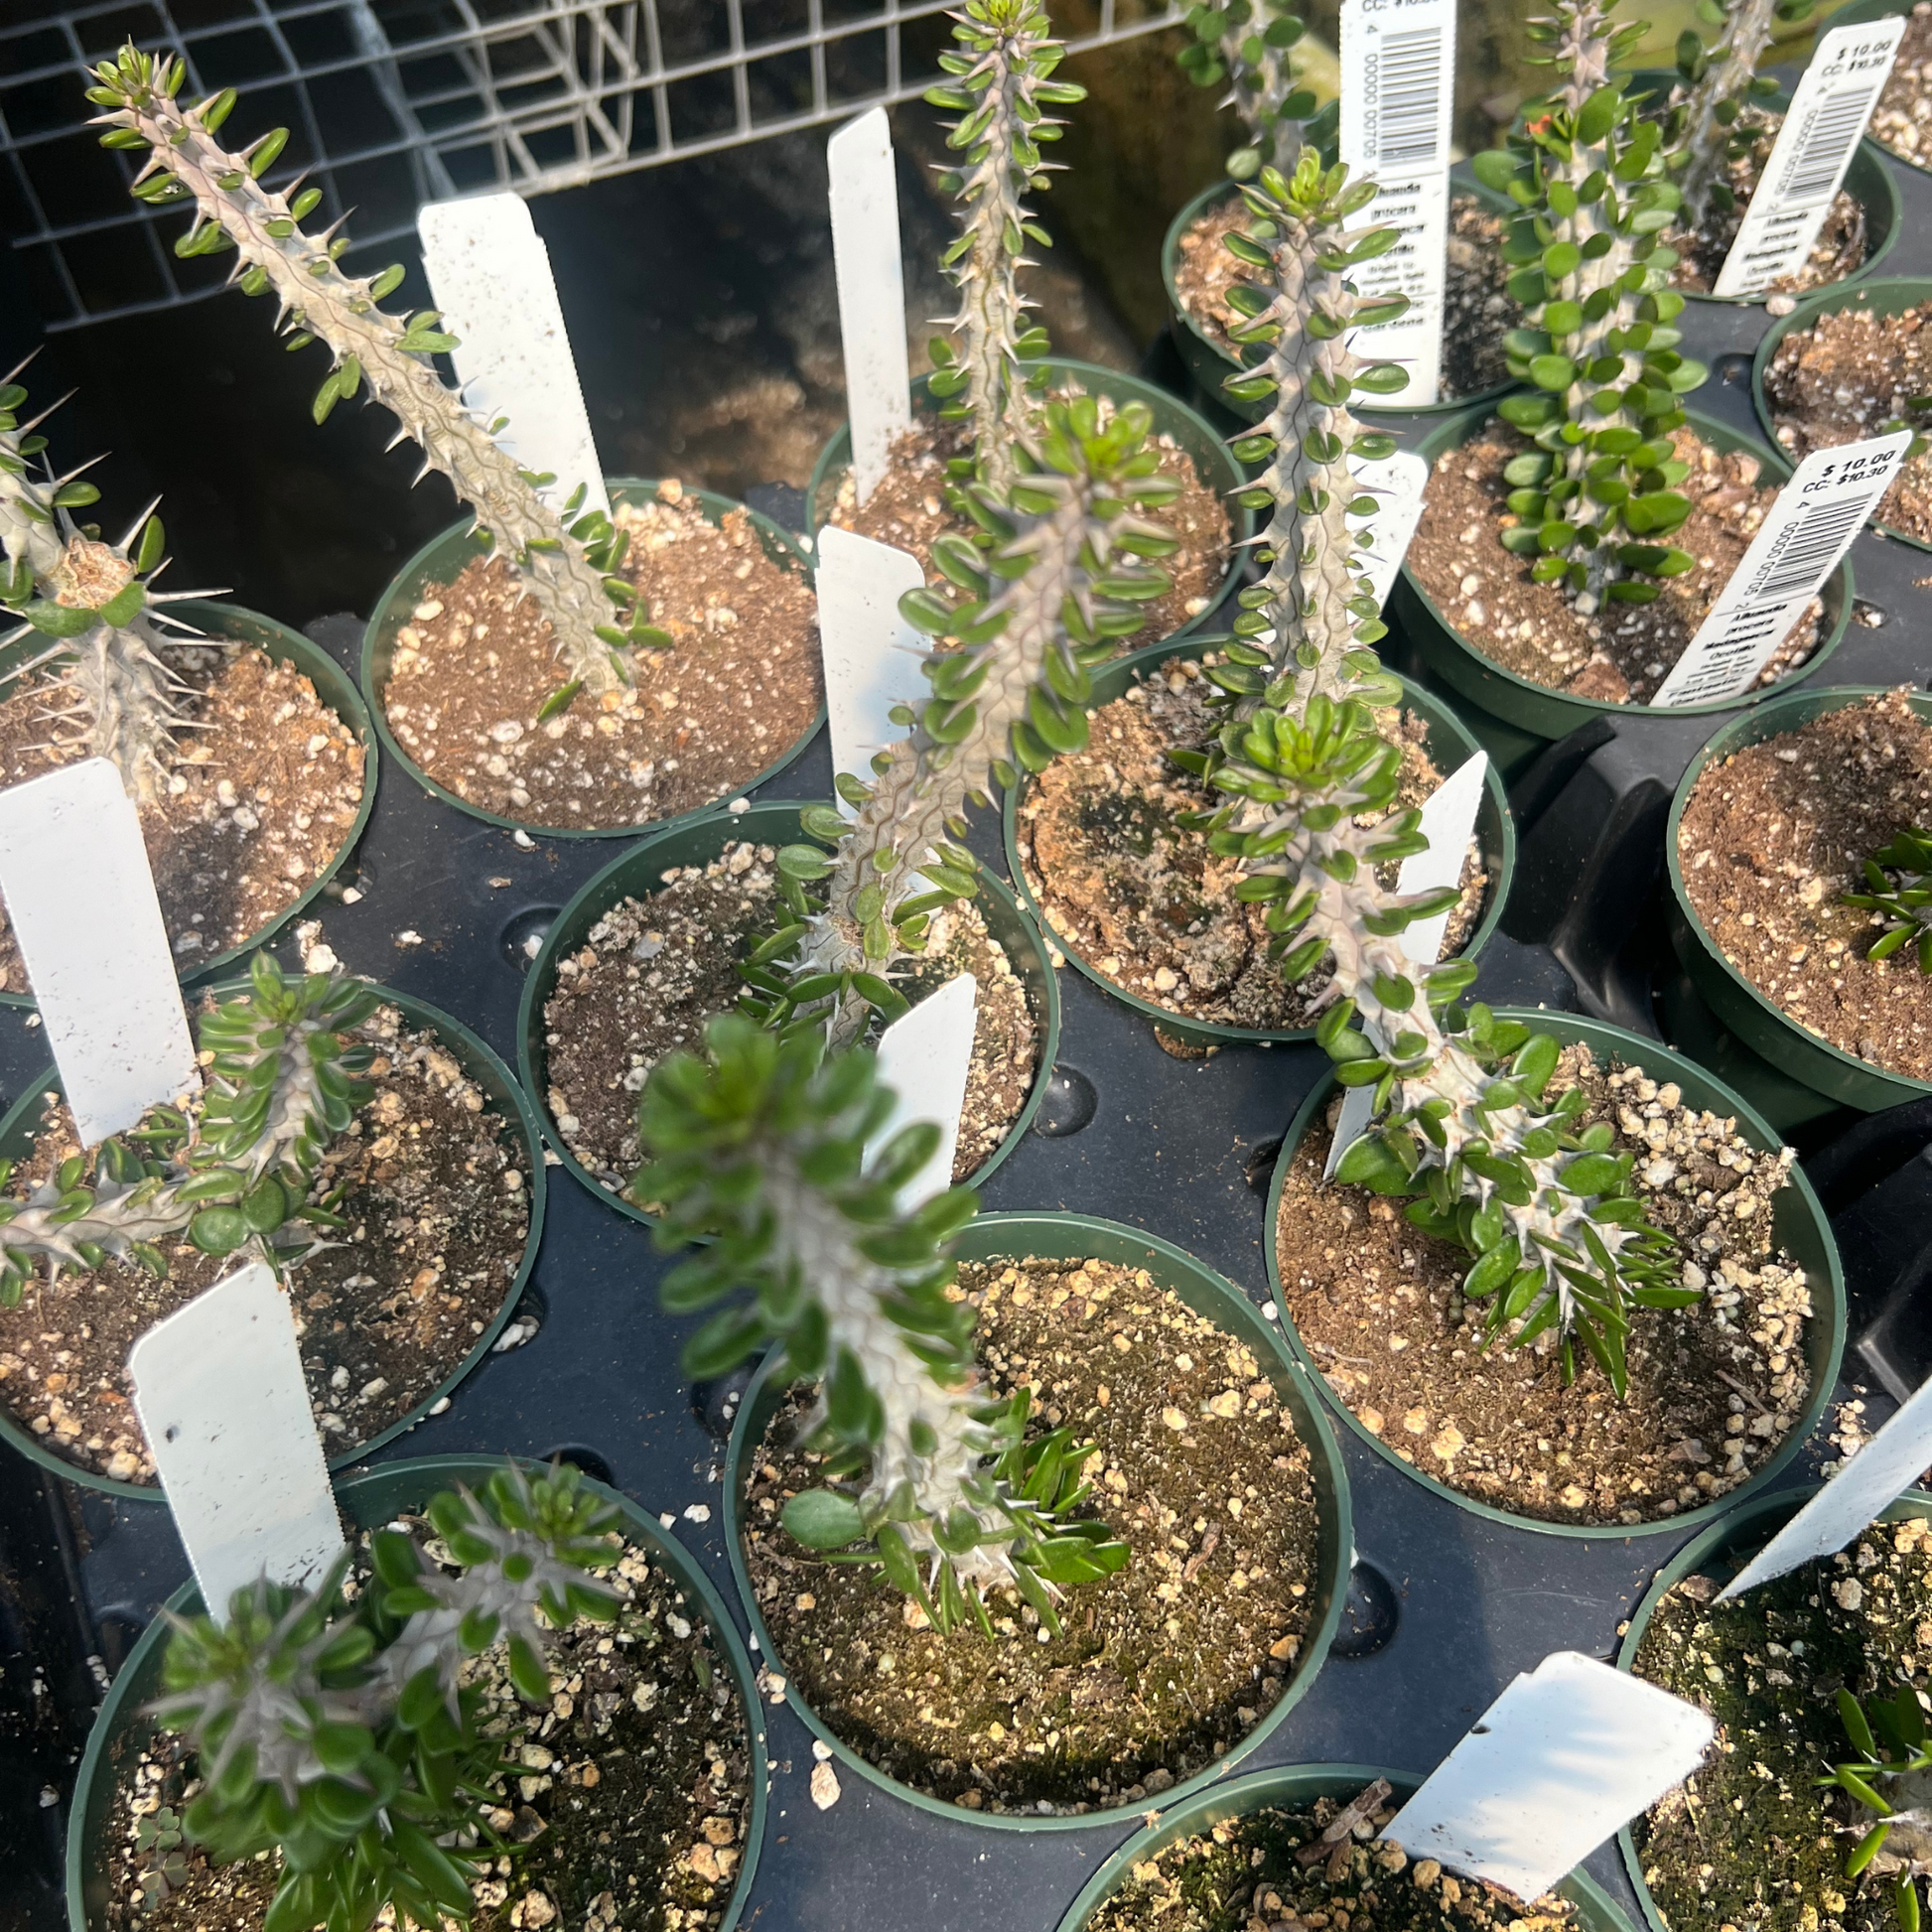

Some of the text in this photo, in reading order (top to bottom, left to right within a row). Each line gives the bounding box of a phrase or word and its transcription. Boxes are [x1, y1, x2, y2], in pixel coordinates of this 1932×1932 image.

[1853, 40, 1892, 58] 10.00
[1364, 54, 1379, 105] 00000
[1802, 465, 1888, 493] CC: $10.30
[1822, 450, 1896, 479] $ 10.00
[1767, 521, 1799, 559] 00000
[1743, 561, 1776, 597] 00705
